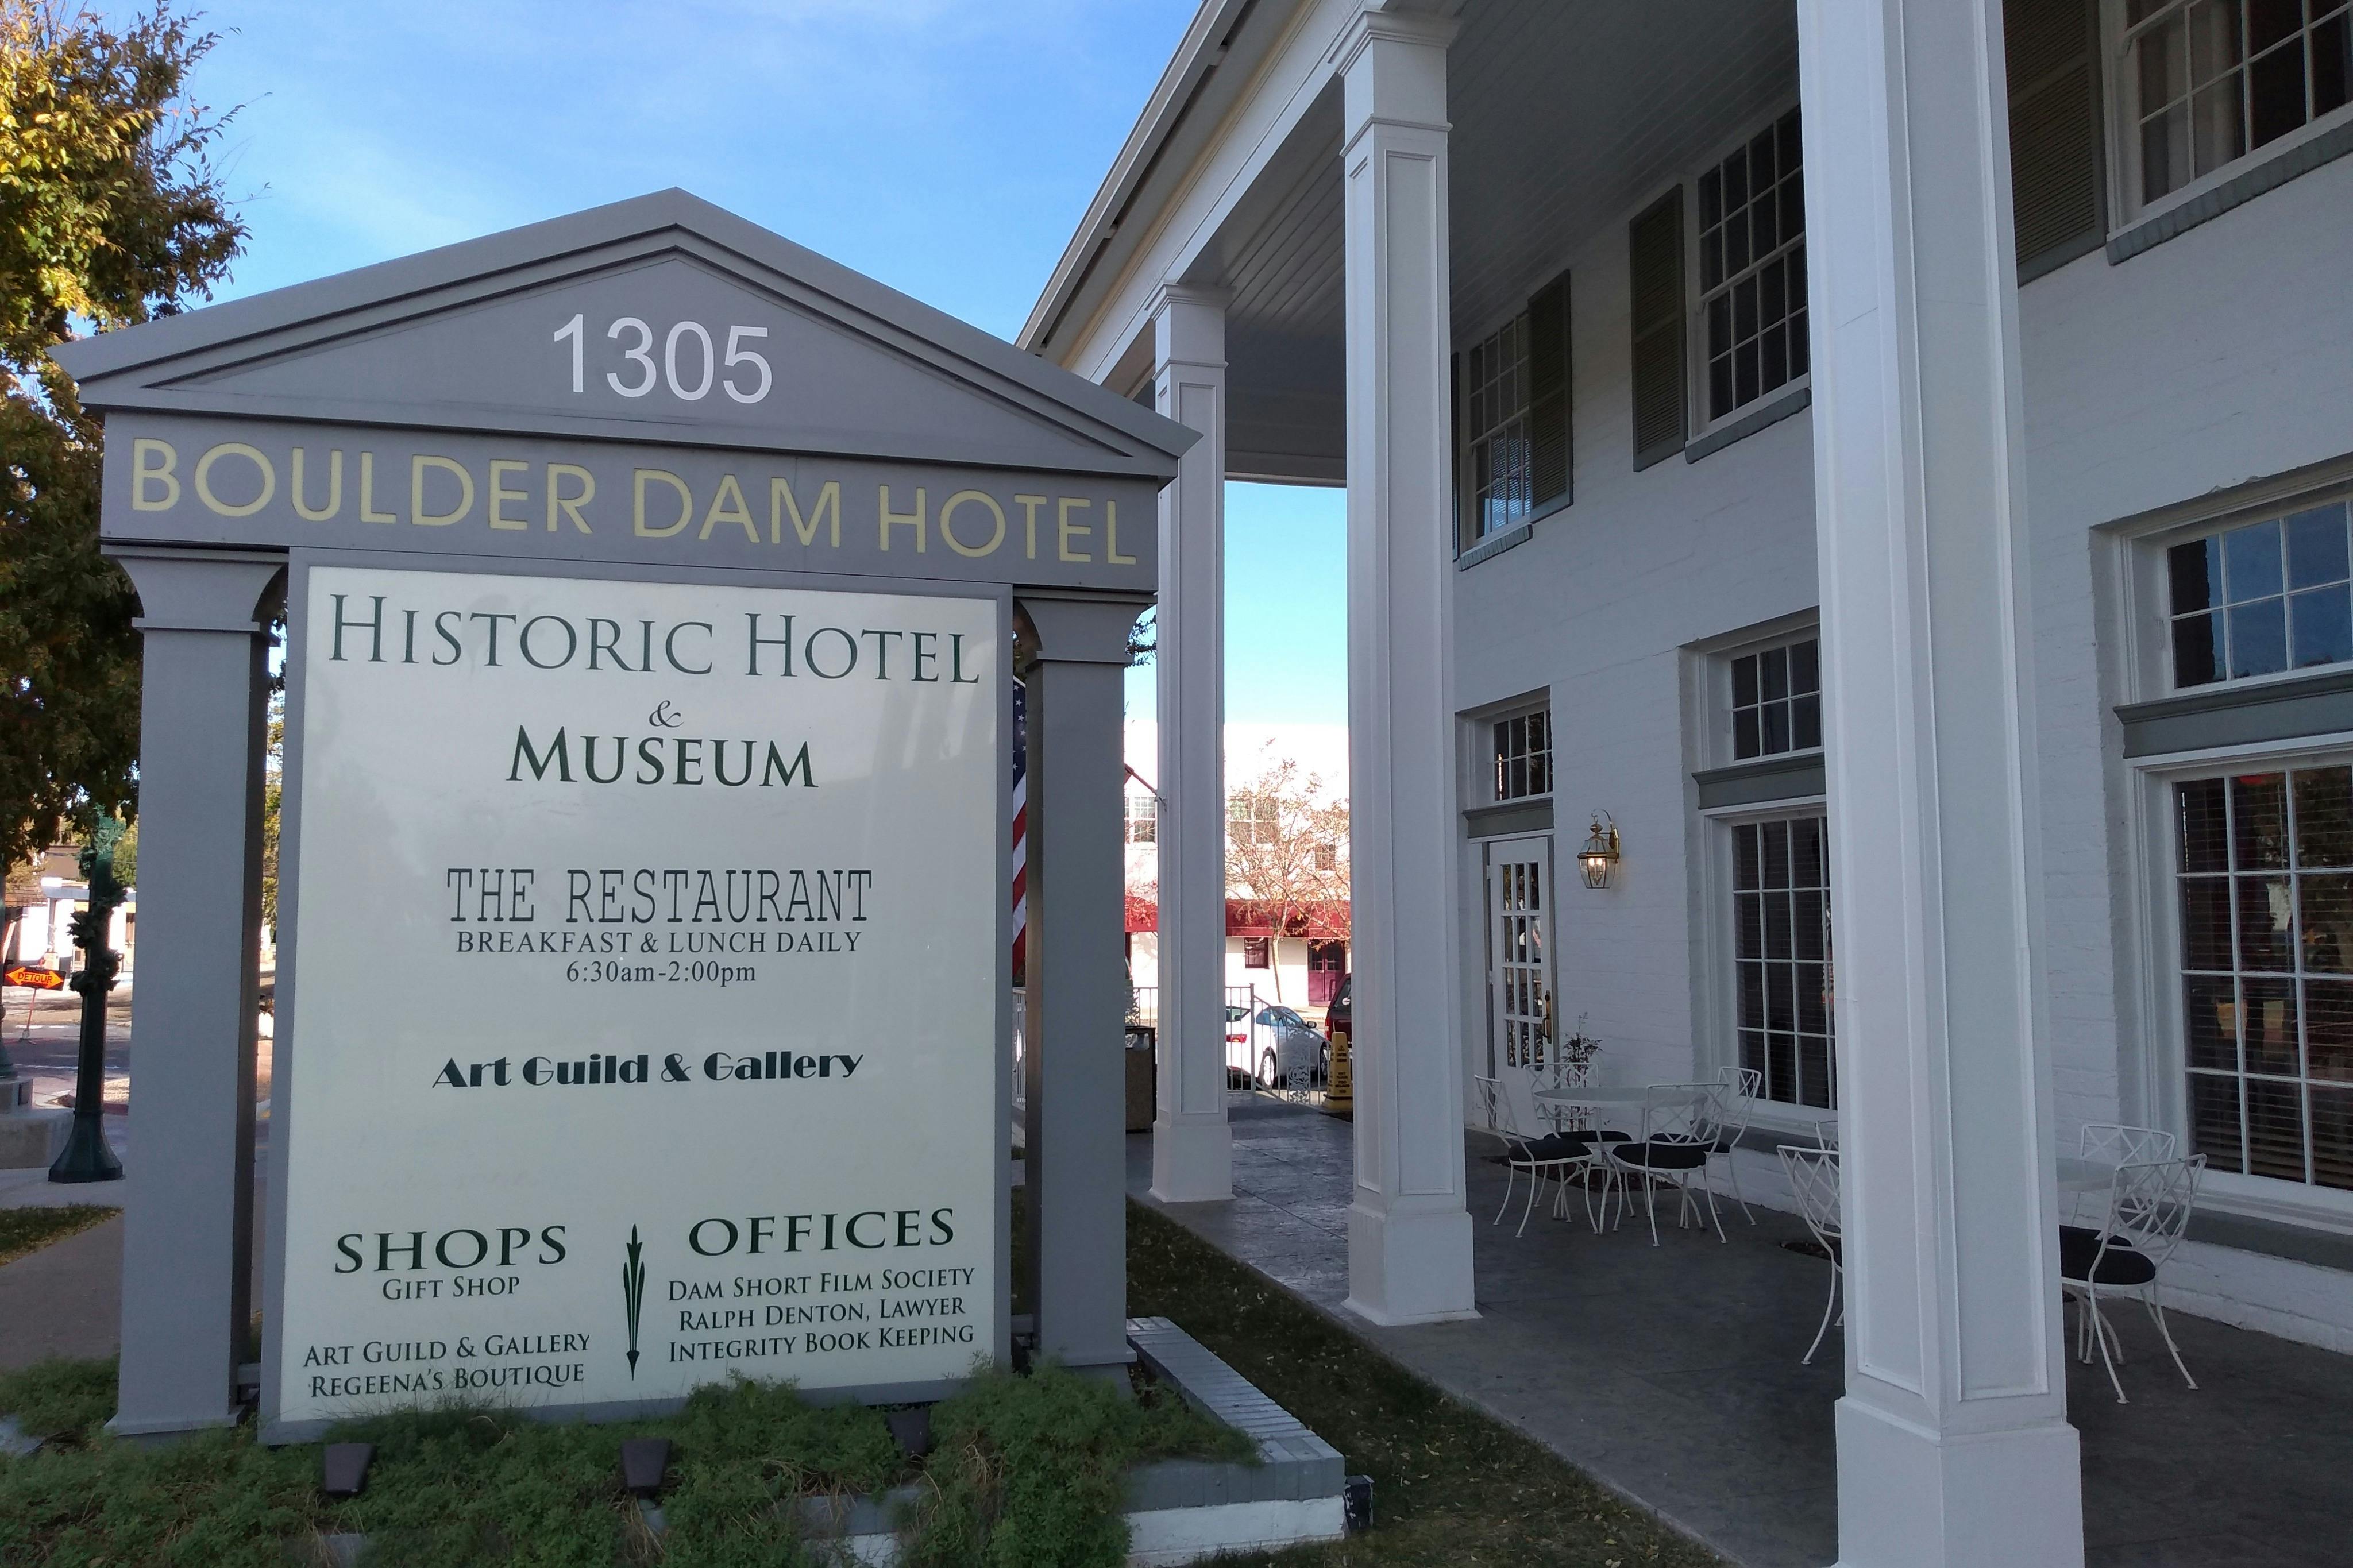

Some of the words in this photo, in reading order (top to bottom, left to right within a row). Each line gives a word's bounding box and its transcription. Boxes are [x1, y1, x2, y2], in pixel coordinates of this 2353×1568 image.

[554, 314, 772, 403] 1305
[132, 437, 599, 534] BOULDER
[634, 469, 840, 547] DAM
[879, 484, 1136, 565] HOTEL
[329, 594, 712, 674] HISTORIC
[745, 613, 979, 683] HOTEL
[649, 701, 683, 727] &
[506, 724, 819, 787] MUSEUM
[448, 868, 534, 921] THE
[566, 869, 871, 923] RESTAURANT
[457, 932, 632, 953] BREAKFAST
[641, 932, 658, 952] &
[669, 932, 766, 952] LUNCH
[776, 932, 861, 952] DAILY
[17, 972, 53, 983] DETOUR
[567, 961, 755, 987] 6:30am-2:00pm
[433, 1057, 511, 1088] Art
[523, 1054, 648, 1086] Guild
[661, 1053, 691, 1082] &
[704, 1051, 863, 1080] Gallery
[335, 1226, 565, 1273] SHOPS
[689, 1208, 953, 1256] OFFICES
[383, 1279, 443, 1300] GIFT
[453, 1276, 519, 1297] SHOP
[669, 1281, 723, 1300] DAM
[734, 1277, 811, 1297] SHORT
[821, 1273, 873, 1292] FILM
[882, 1268, 974, 1289] SOCIETY
[680, 1310, 754, 1331] RALPH
[766, 1303, 869, 1325] DENTON,
[881, 1297, 965, 1318] LAWYER
[303, 1346, 354, 1367] ART
[363, 1342, 446, 1362] GUILD
[457, 1337, 476, 1358] &
[485, 1334, 589, 1355] GALLERY
[670, 1337, 796, 1362] INTEGRITY
[806, 1332, 870, 1352] BOOK
[879, 1326, 974, 1347] KEEPING
[311, 1369, 443, 1397] REGEENA'S
[455, 1364, 584, 1388] BOUTIQUE
